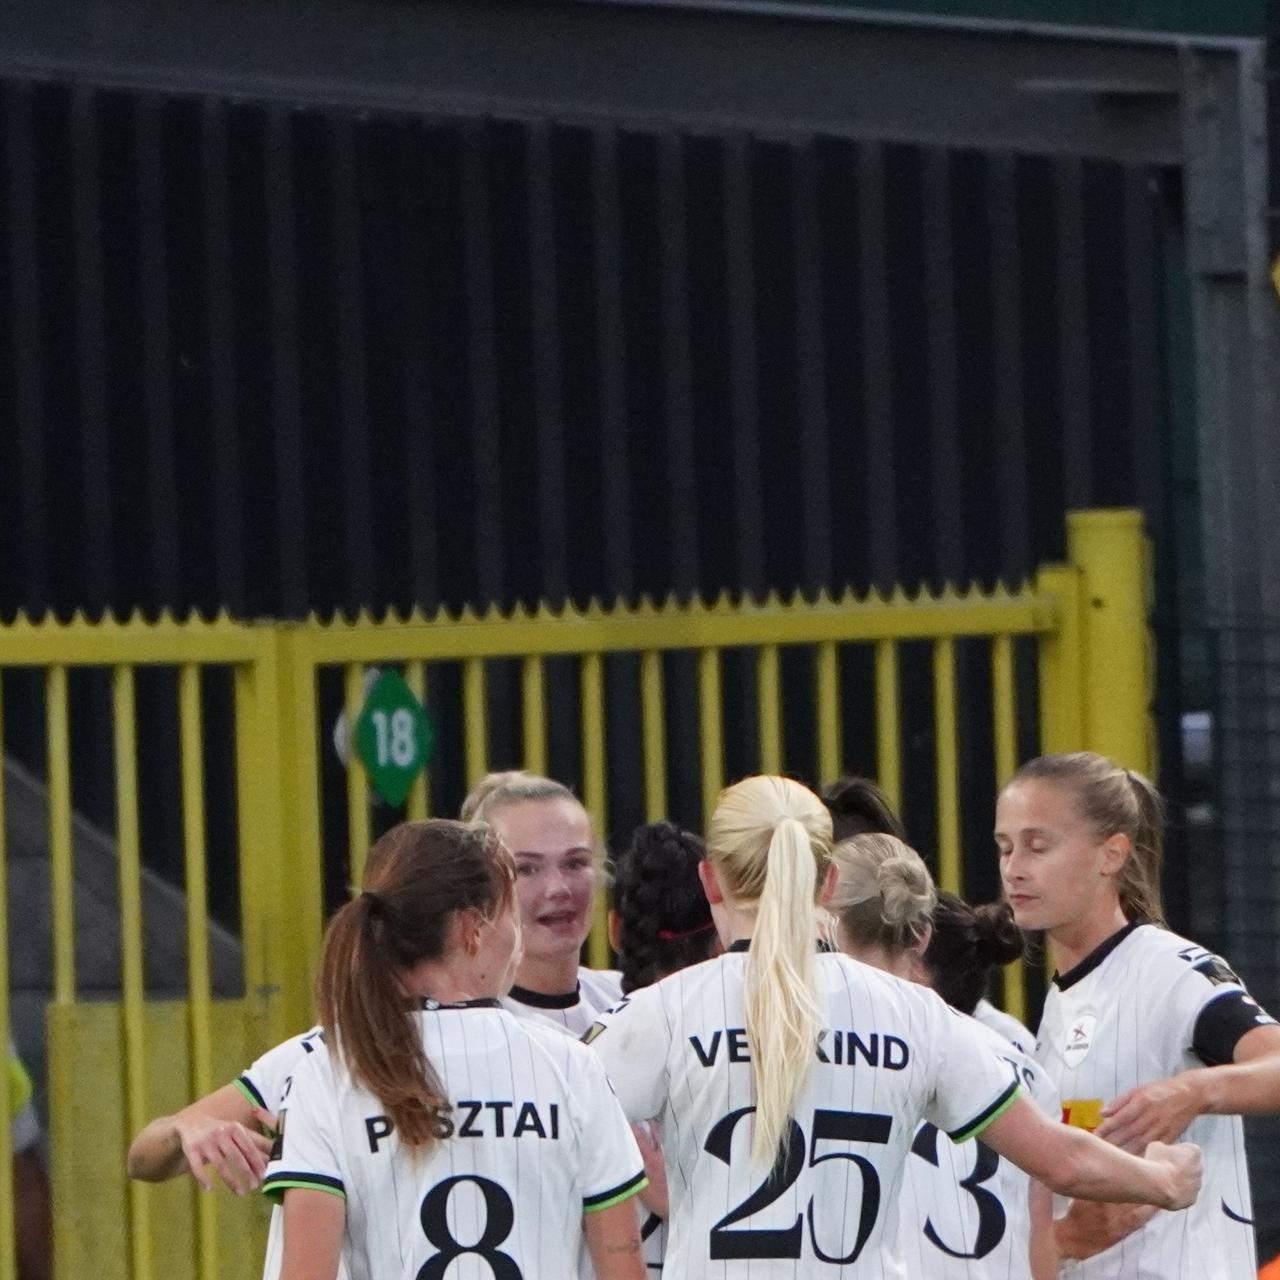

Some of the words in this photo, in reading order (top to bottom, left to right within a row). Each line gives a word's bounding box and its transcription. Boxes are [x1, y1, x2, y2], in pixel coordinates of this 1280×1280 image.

[371, 708, 417, 767] 18
[689, 1028, 910, 1071] VEKIND
[365, 1101, 559, 1153] PSZTAI
[704, 1106, 893, 1265] 25
